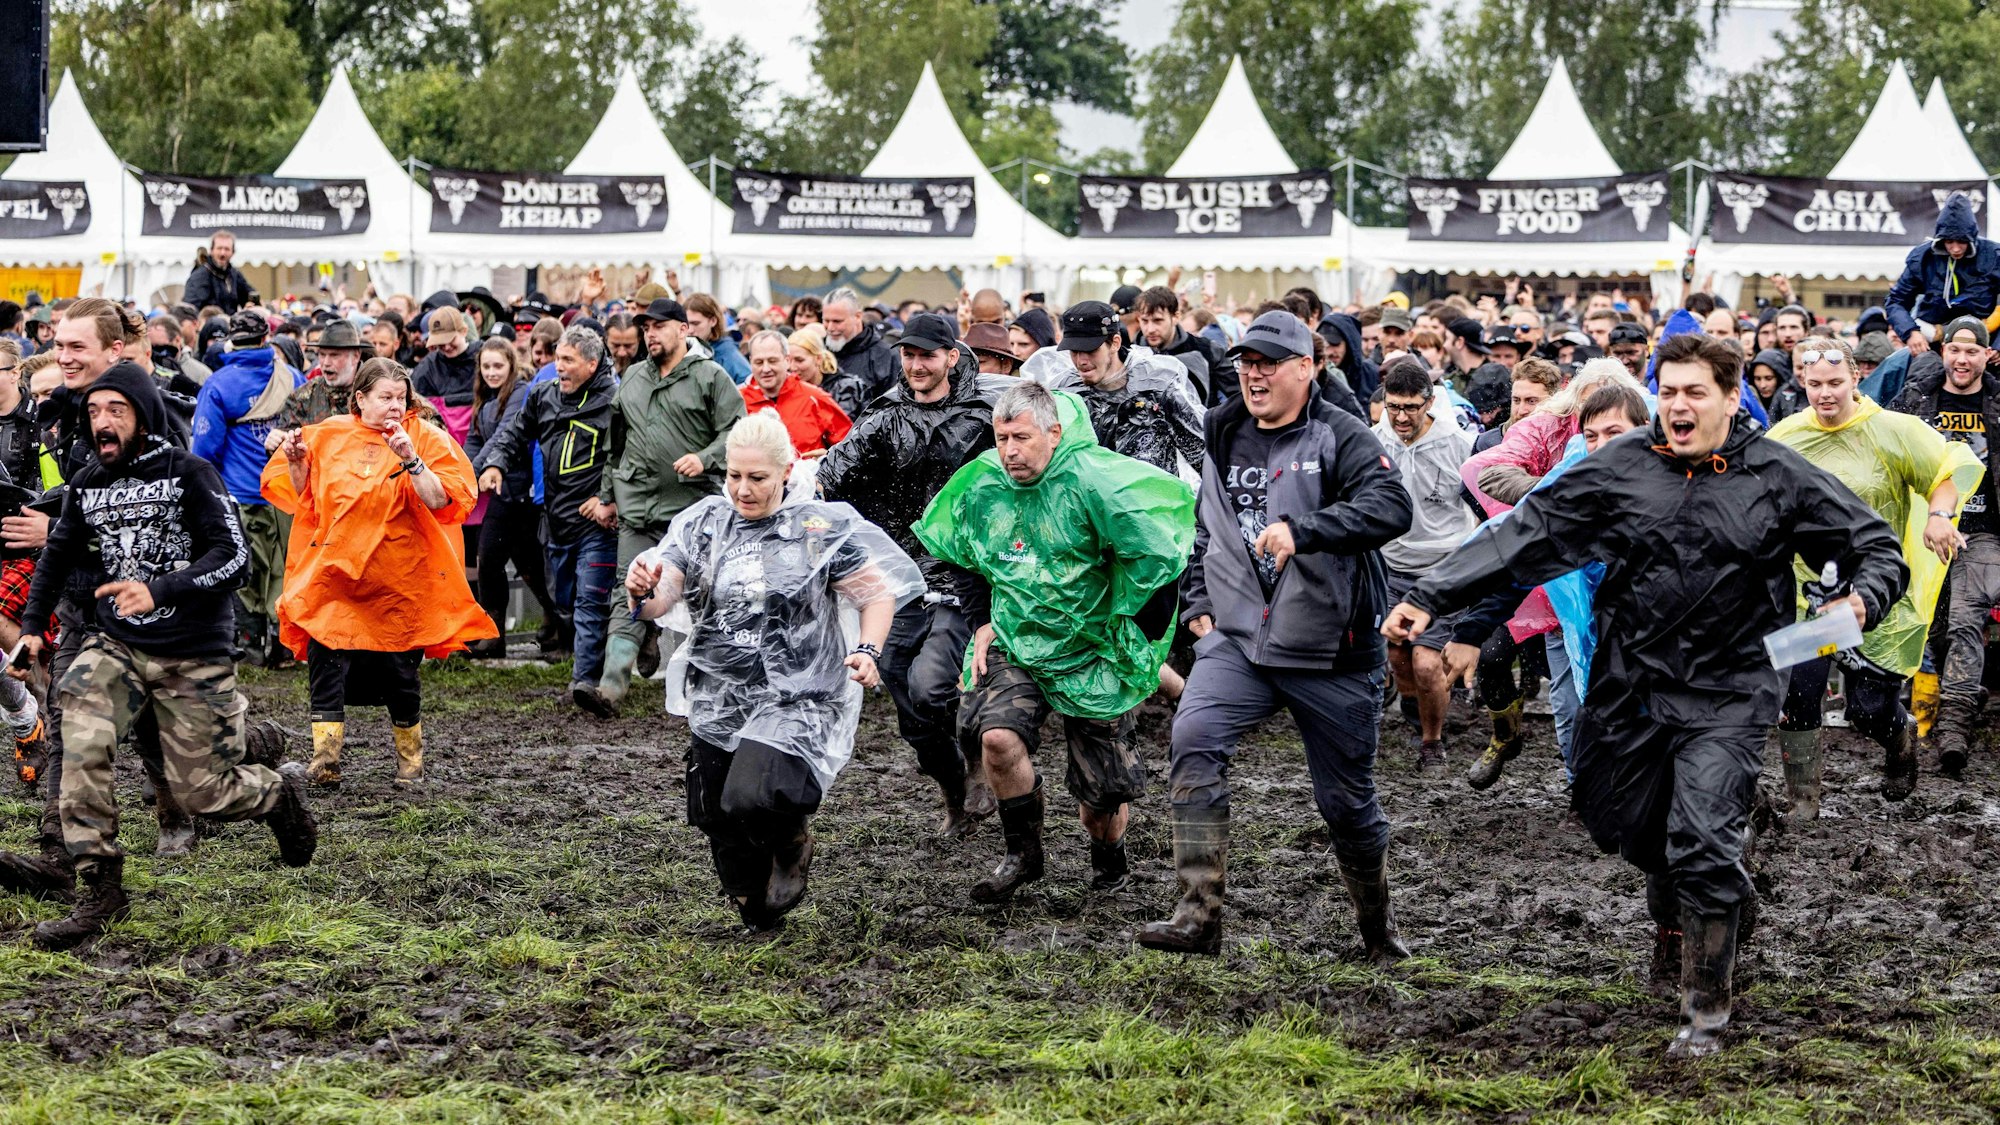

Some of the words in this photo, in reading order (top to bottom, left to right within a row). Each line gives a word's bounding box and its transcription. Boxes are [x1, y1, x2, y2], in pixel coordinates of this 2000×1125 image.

[218, 184, 299, 212] LANGOS
[501, 178, 600, 204] DÖNER
[1139, 180, 1273, 210] SLUSH
[1477, 186, 1600, 213] FINGER
[1808, 189, 1894, 212] ASIA
[499, 206, 602, 229] KEBAP
[787, 195, 837, 214] ODER
[1175, 208, 1242, 234] ICE
[1497, 211, 1583, 235] FOOD
[1793, 209, 1907, 235] CHINA
[75, 477, 184, 515] WACKEN
[93, 504, 154, 526] 2023
[998, 551, 1036, 564] Heineken
